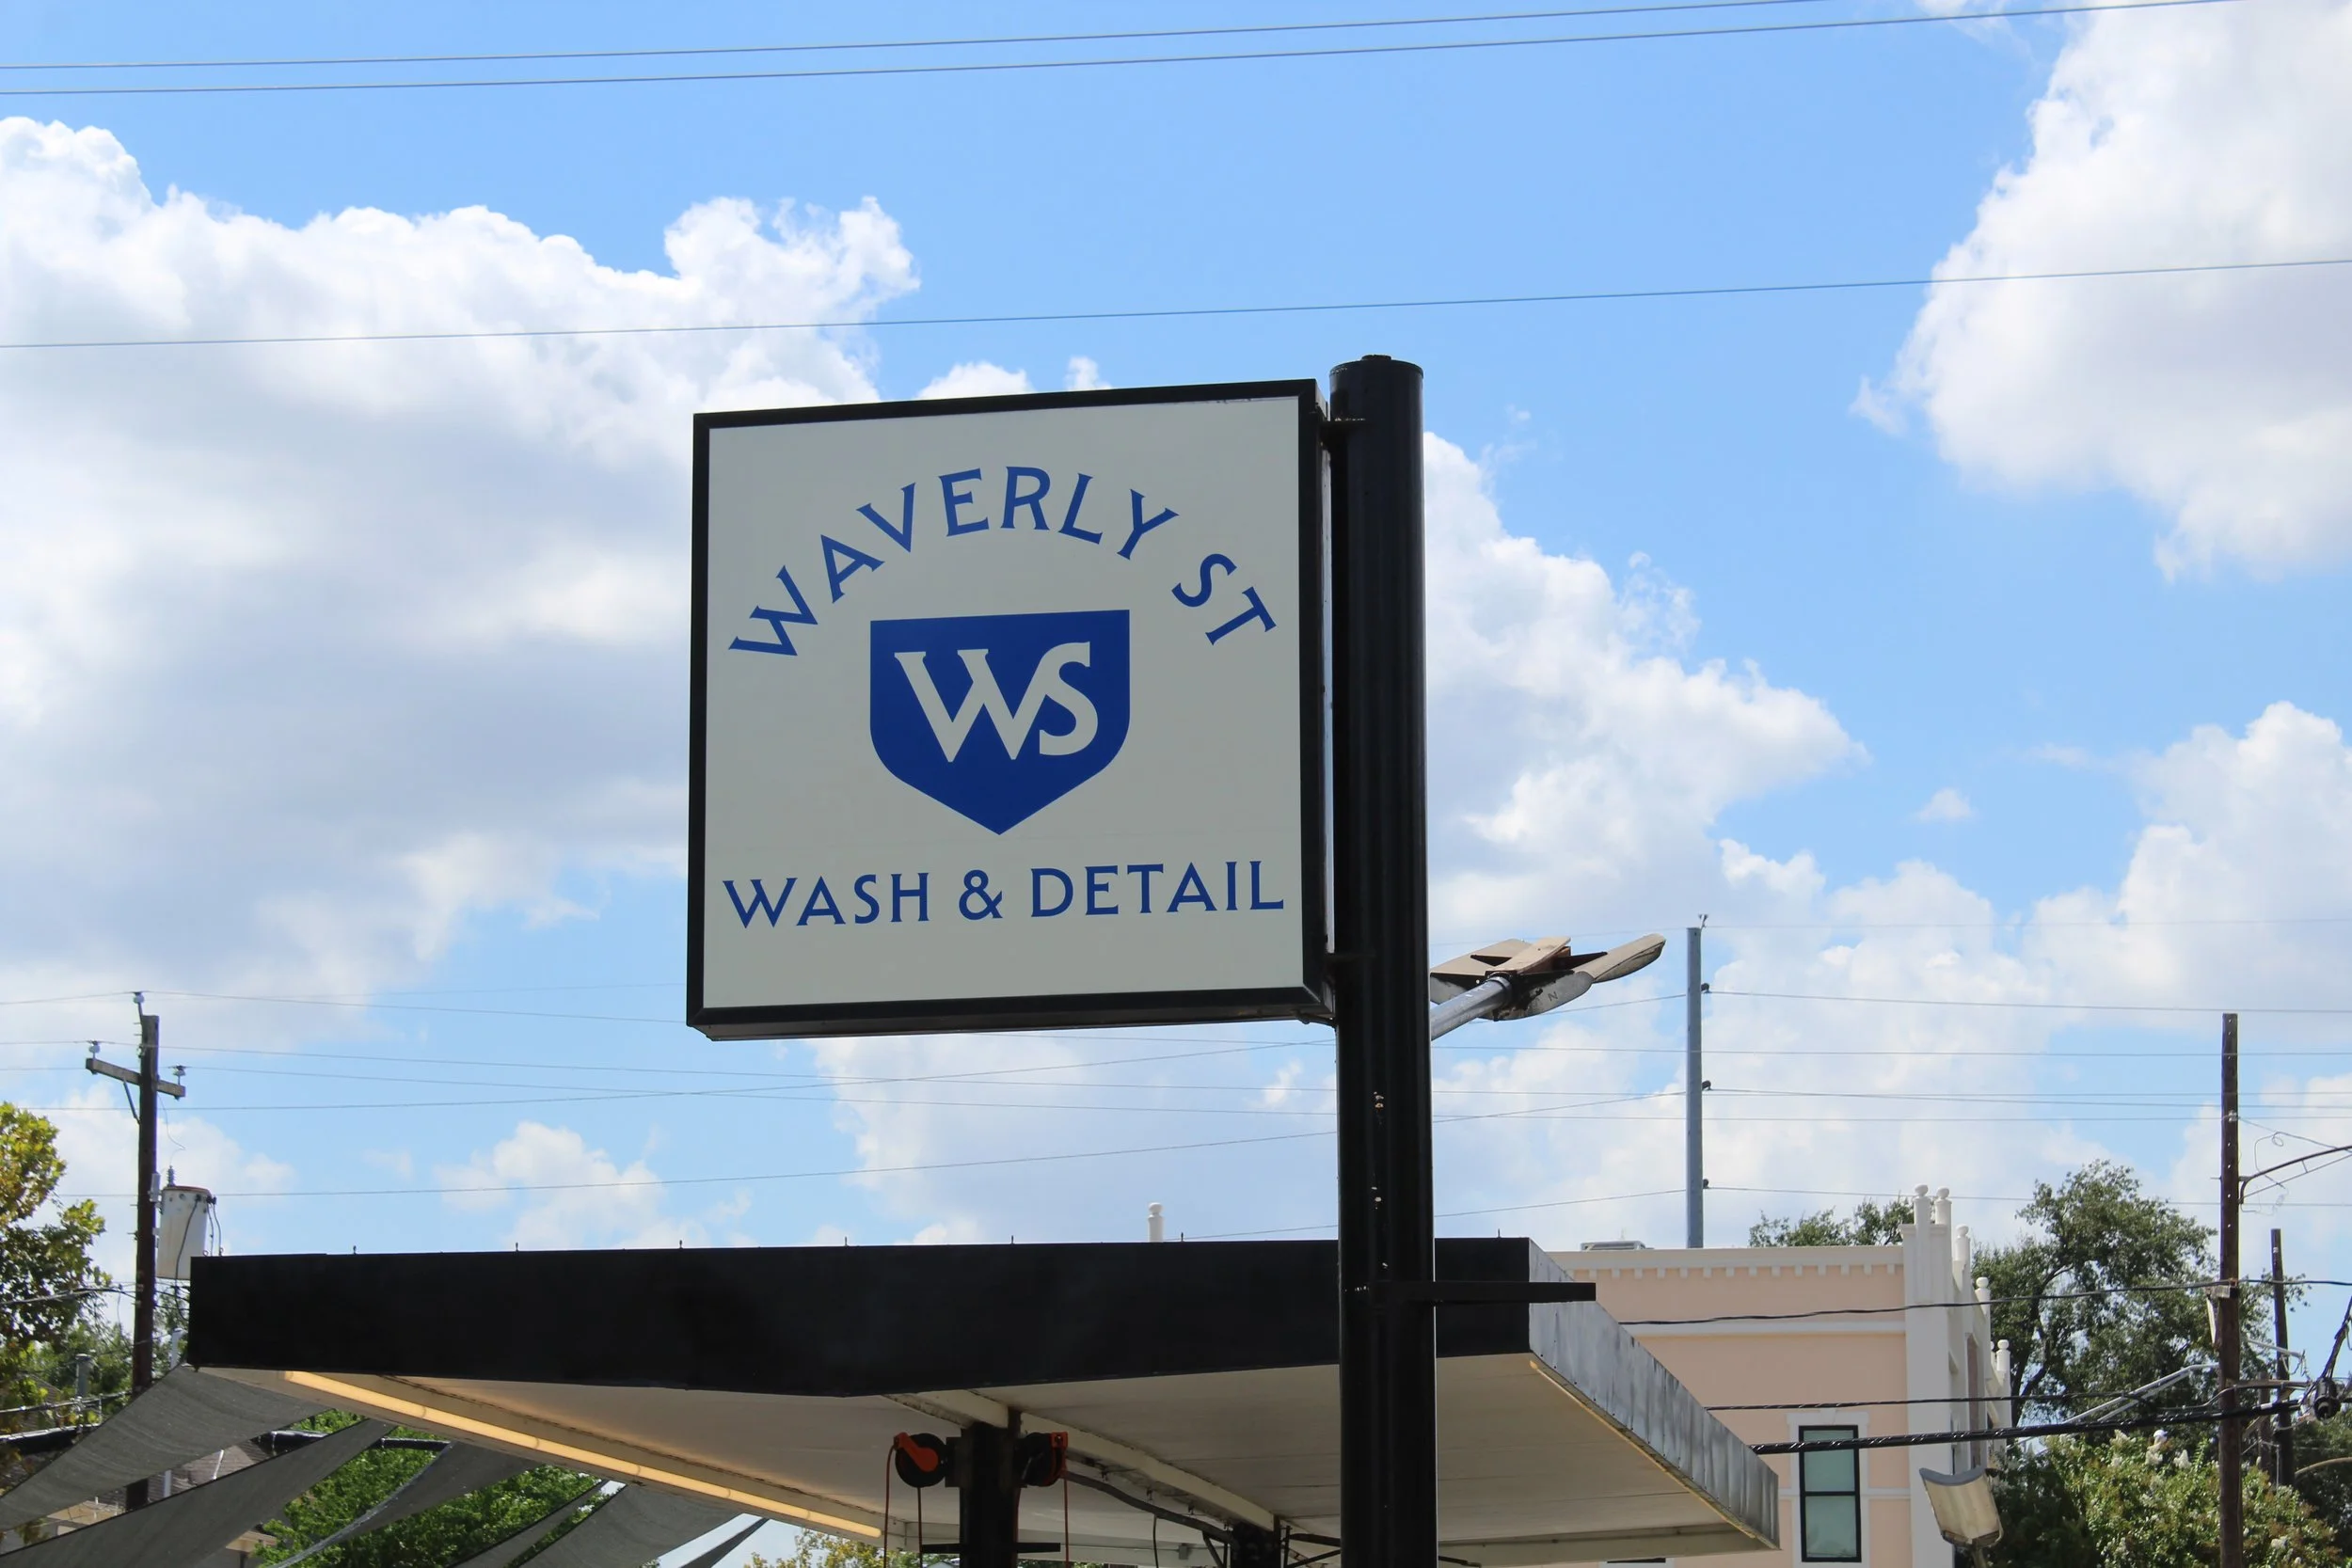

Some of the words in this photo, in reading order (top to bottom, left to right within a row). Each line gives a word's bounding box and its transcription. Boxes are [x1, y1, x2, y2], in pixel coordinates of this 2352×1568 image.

[728, 466, 1179, 657] WAVERLY
[1171, 552, 1278, 645] ST
[893, 641, 1100, 764] WS
[723, 871, 931, 928] WASH
[957, 867, 1004, 922] &
[1030, 860, 1285, 919] DETAIL
